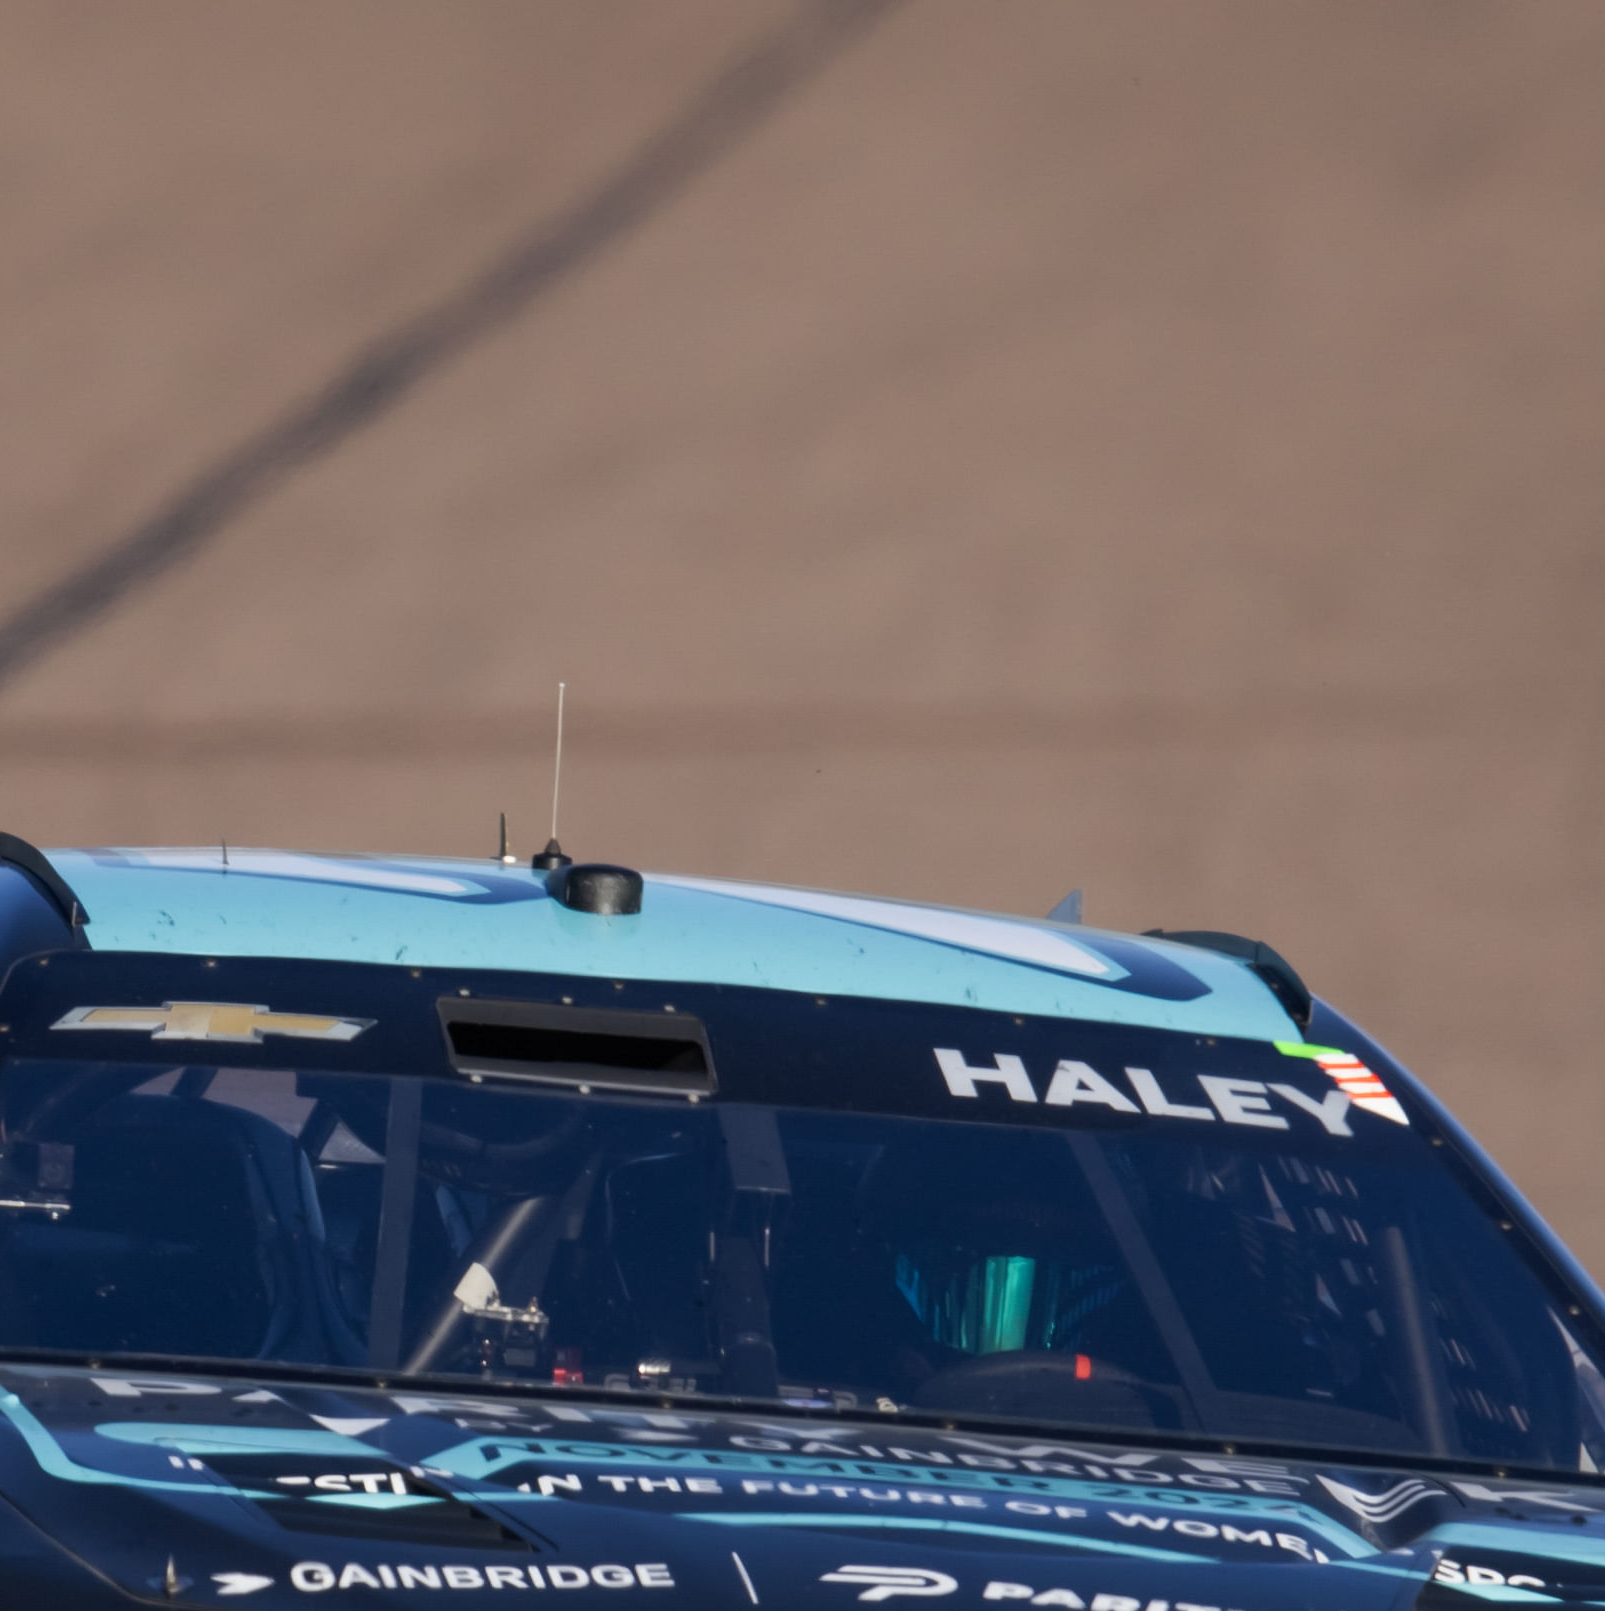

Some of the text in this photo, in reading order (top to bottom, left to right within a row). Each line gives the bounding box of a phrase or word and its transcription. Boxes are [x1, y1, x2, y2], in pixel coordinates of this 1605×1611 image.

[933, 1047, 1354, 1138] HALEY
[729, 1435, 1301, 1496] GAINBRIDGE
[597, 1474, 724, 1494] THE
[741, 1478, 989, 1509] FUTURE
[1004, 1501, 1089, 1520] OF
[290, 1562, 676, 1593] GAINBRIDGE
